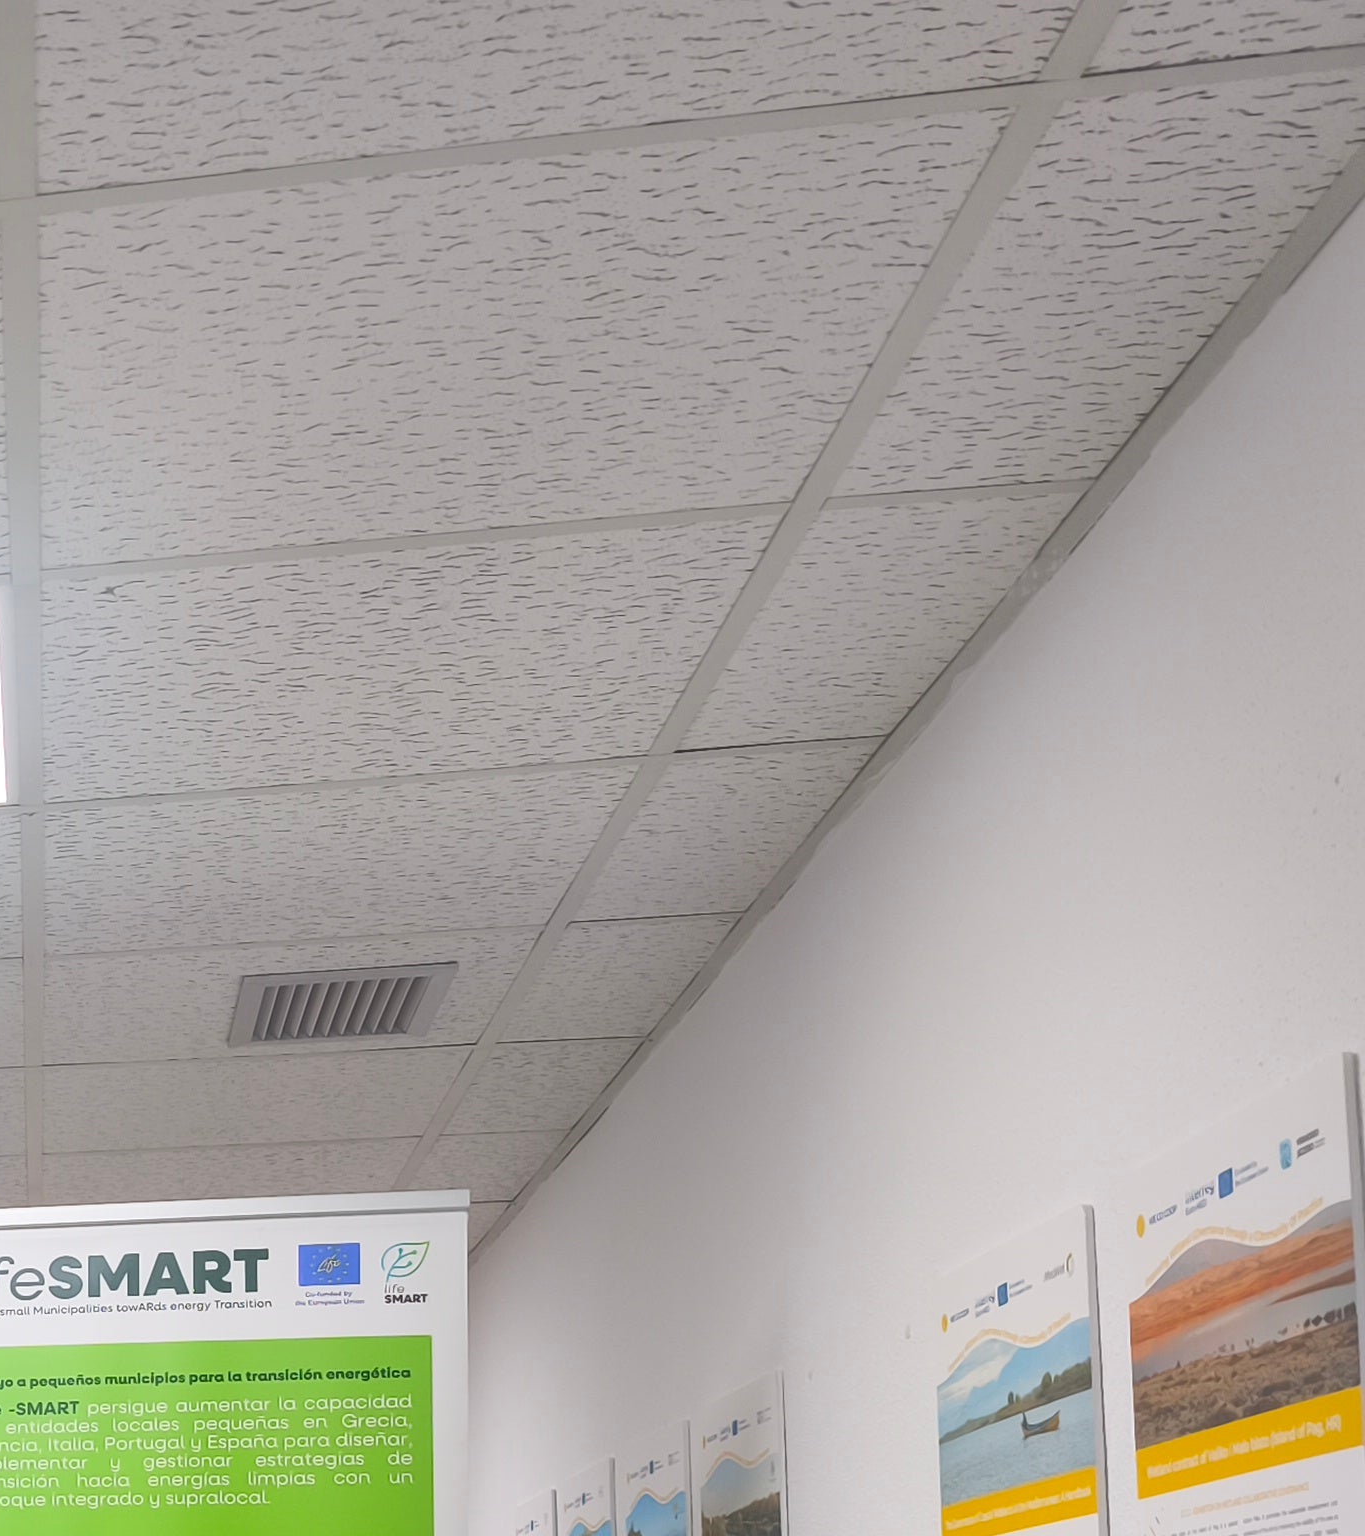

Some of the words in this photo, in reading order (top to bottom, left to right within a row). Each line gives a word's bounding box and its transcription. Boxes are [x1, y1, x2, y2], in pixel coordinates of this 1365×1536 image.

[384, 1283, 405, 1294] life
[384, 1293, 428, 1304] SMART
[0, 1307, 29, 1316] small
[34, 1305, 112, 1315] Municipalities
[117, 1302, 166, 1312] towARds
[170, 1303, 210, 1311] energy
[215, 1300, 272, 1308] Transition
[30, 1375, 101, 1389] pequeños
[105, 1372, 185, 1386] municipios
[190, 1374, 224, 1385] para
[228, 1372, 242, 1381] la
[246, 1369, 322, 1381] transición
[88, 1402, 167, 1417] persigue
[176, 1399, 270, 1413] aumentar
[278, 1397, 296, 1410] la
[305, 1395, 411, 1412] capacidad
[6, 1420, 98, 1434] entidades
[113, 1418, 179, 1432] locales
[194, 1416, 288, 1433] pequeñas
[304, 1418, 327, 1428] en
[342, 1414, 413, 1430] Grecia,
[49, 1437, 98, 1451] Italia,
[105, 1436, 184, 1454] Portugal
[190, 1439, 201, 1452] y
[206, 1435, 278, 1451] España
[283, 1436, 330, 1450] para
[336, 1433, 413, 1449] diseñar,
[111, 1459, 120, 1472] y
[143, 1455, 232, 1471] gestionar
[256, 1453, 365, 1469] estrategias
[388, 1451, 412, 1465] de
[78, 1473, 130, 1487] hacia
[249, 1472, 315, 1488] limpias
[334, 1472, 371, 1485] con
[390, 1472, 412, 1483] un
[52, 1492, 143, 1509] integrado
[150, 1495, 160, 1508] y
